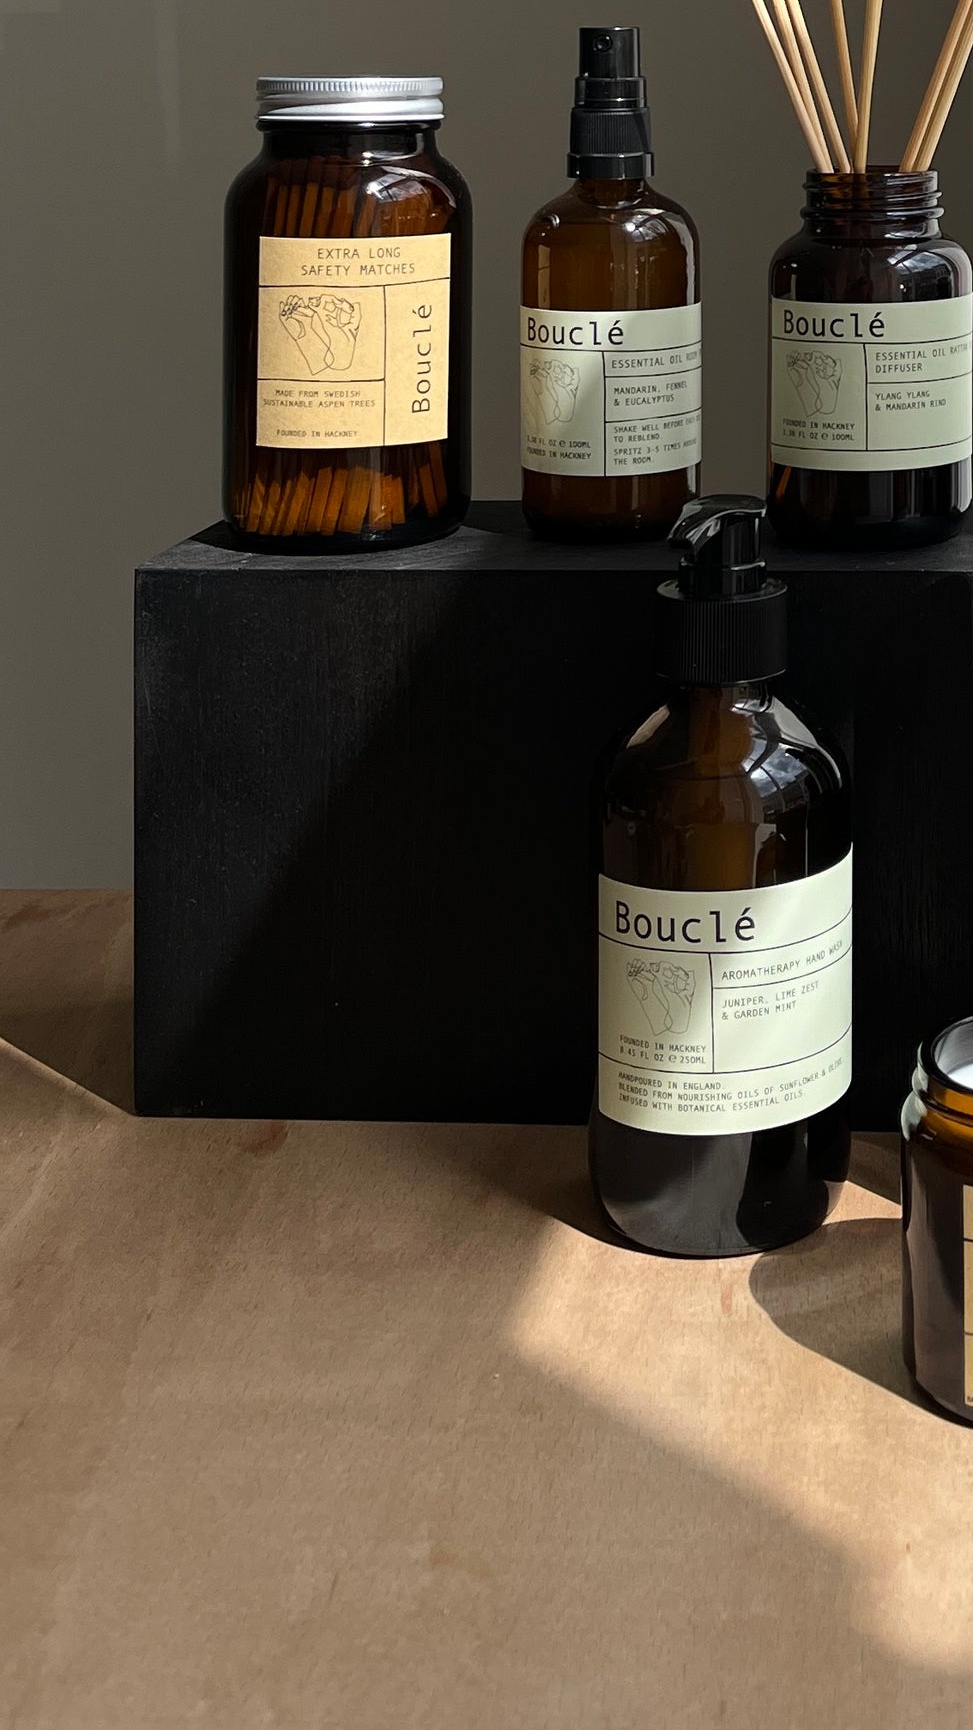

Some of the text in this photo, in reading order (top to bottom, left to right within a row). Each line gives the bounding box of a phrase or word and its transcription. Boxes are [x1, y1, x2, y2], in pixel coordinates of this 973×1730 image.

[318, 247, 401, 259] EXTRA LONG
[301, 263, 415, 276] SAFETY MATCHES
[784, 309, 885, 338] Bouclé
[528, 317, 624, 345] Bouclé
[412, 304, 432, 413] Bouclé
[875, 348, 946, 361] ESSENTIAL OIL
[611, 355, 683, 368] ESSENTIAL OIL
[875, 363, 923, 373] DIFFUSER
[666, 381, 687, 390] FENNEL
[324, 390, 361, 398] SWEDISH
[614, 395, 675, 406] & EUCALYPTUS
[875, 390, 930, 401] YLANG YLANG
[263, 399, 313, 408] SUSTAINABLE
[886, 401, 926, 411] MANDARIN
[930, 399, 946, 408] RIND
[614, 425, 637, 433] SHAKE
[642, 424, 659, 432] WELL
[663, 420, 684, 429] BEFORE
[822, 422, 855, 430] HACKNEY
[276, 430, 307, 438] FOUNDED
[325, 430, 358, 438] HACKNEY
[832, 433, 855, 441] 100ML
[549, 439, 557, 447] OZ
[614, 447, 642, 456] SPRITZ
[663, 443, 681, 452] TIMES
[549, 450, 557, 458] IN
[615, 900, 756, 943] Bouclé
[722, 940, 843, 980] AROMATHERAPY HAND WASH
[776, 989, 796, 1001] LIME
[802, 981, 819, 994] ZEST
[722, 1000, 797, 1020] & GARDEN MINT
[620, 1035, 649, 1048] FOUNDED
[641, 1051, 649, 1059] FL
[680, 1056, 706, 1064] 250ML
[618, 1072, 677, 1089] HANDPOURED IN
[618, 1082, 648, 1096] BLENDED
[653, 1091, 672, 1099] FROM
[678, 1092, 732, 1101] NOURISHING
[737, 1089, 759, 1099] OILS
[764, 1087, 773, 1095] OF
[780, 1073, 818, 1092] SUNFLOWER
[619, 1093, 779, 1112] INFUSED WITH BOTANICAL ESSENTIAL
